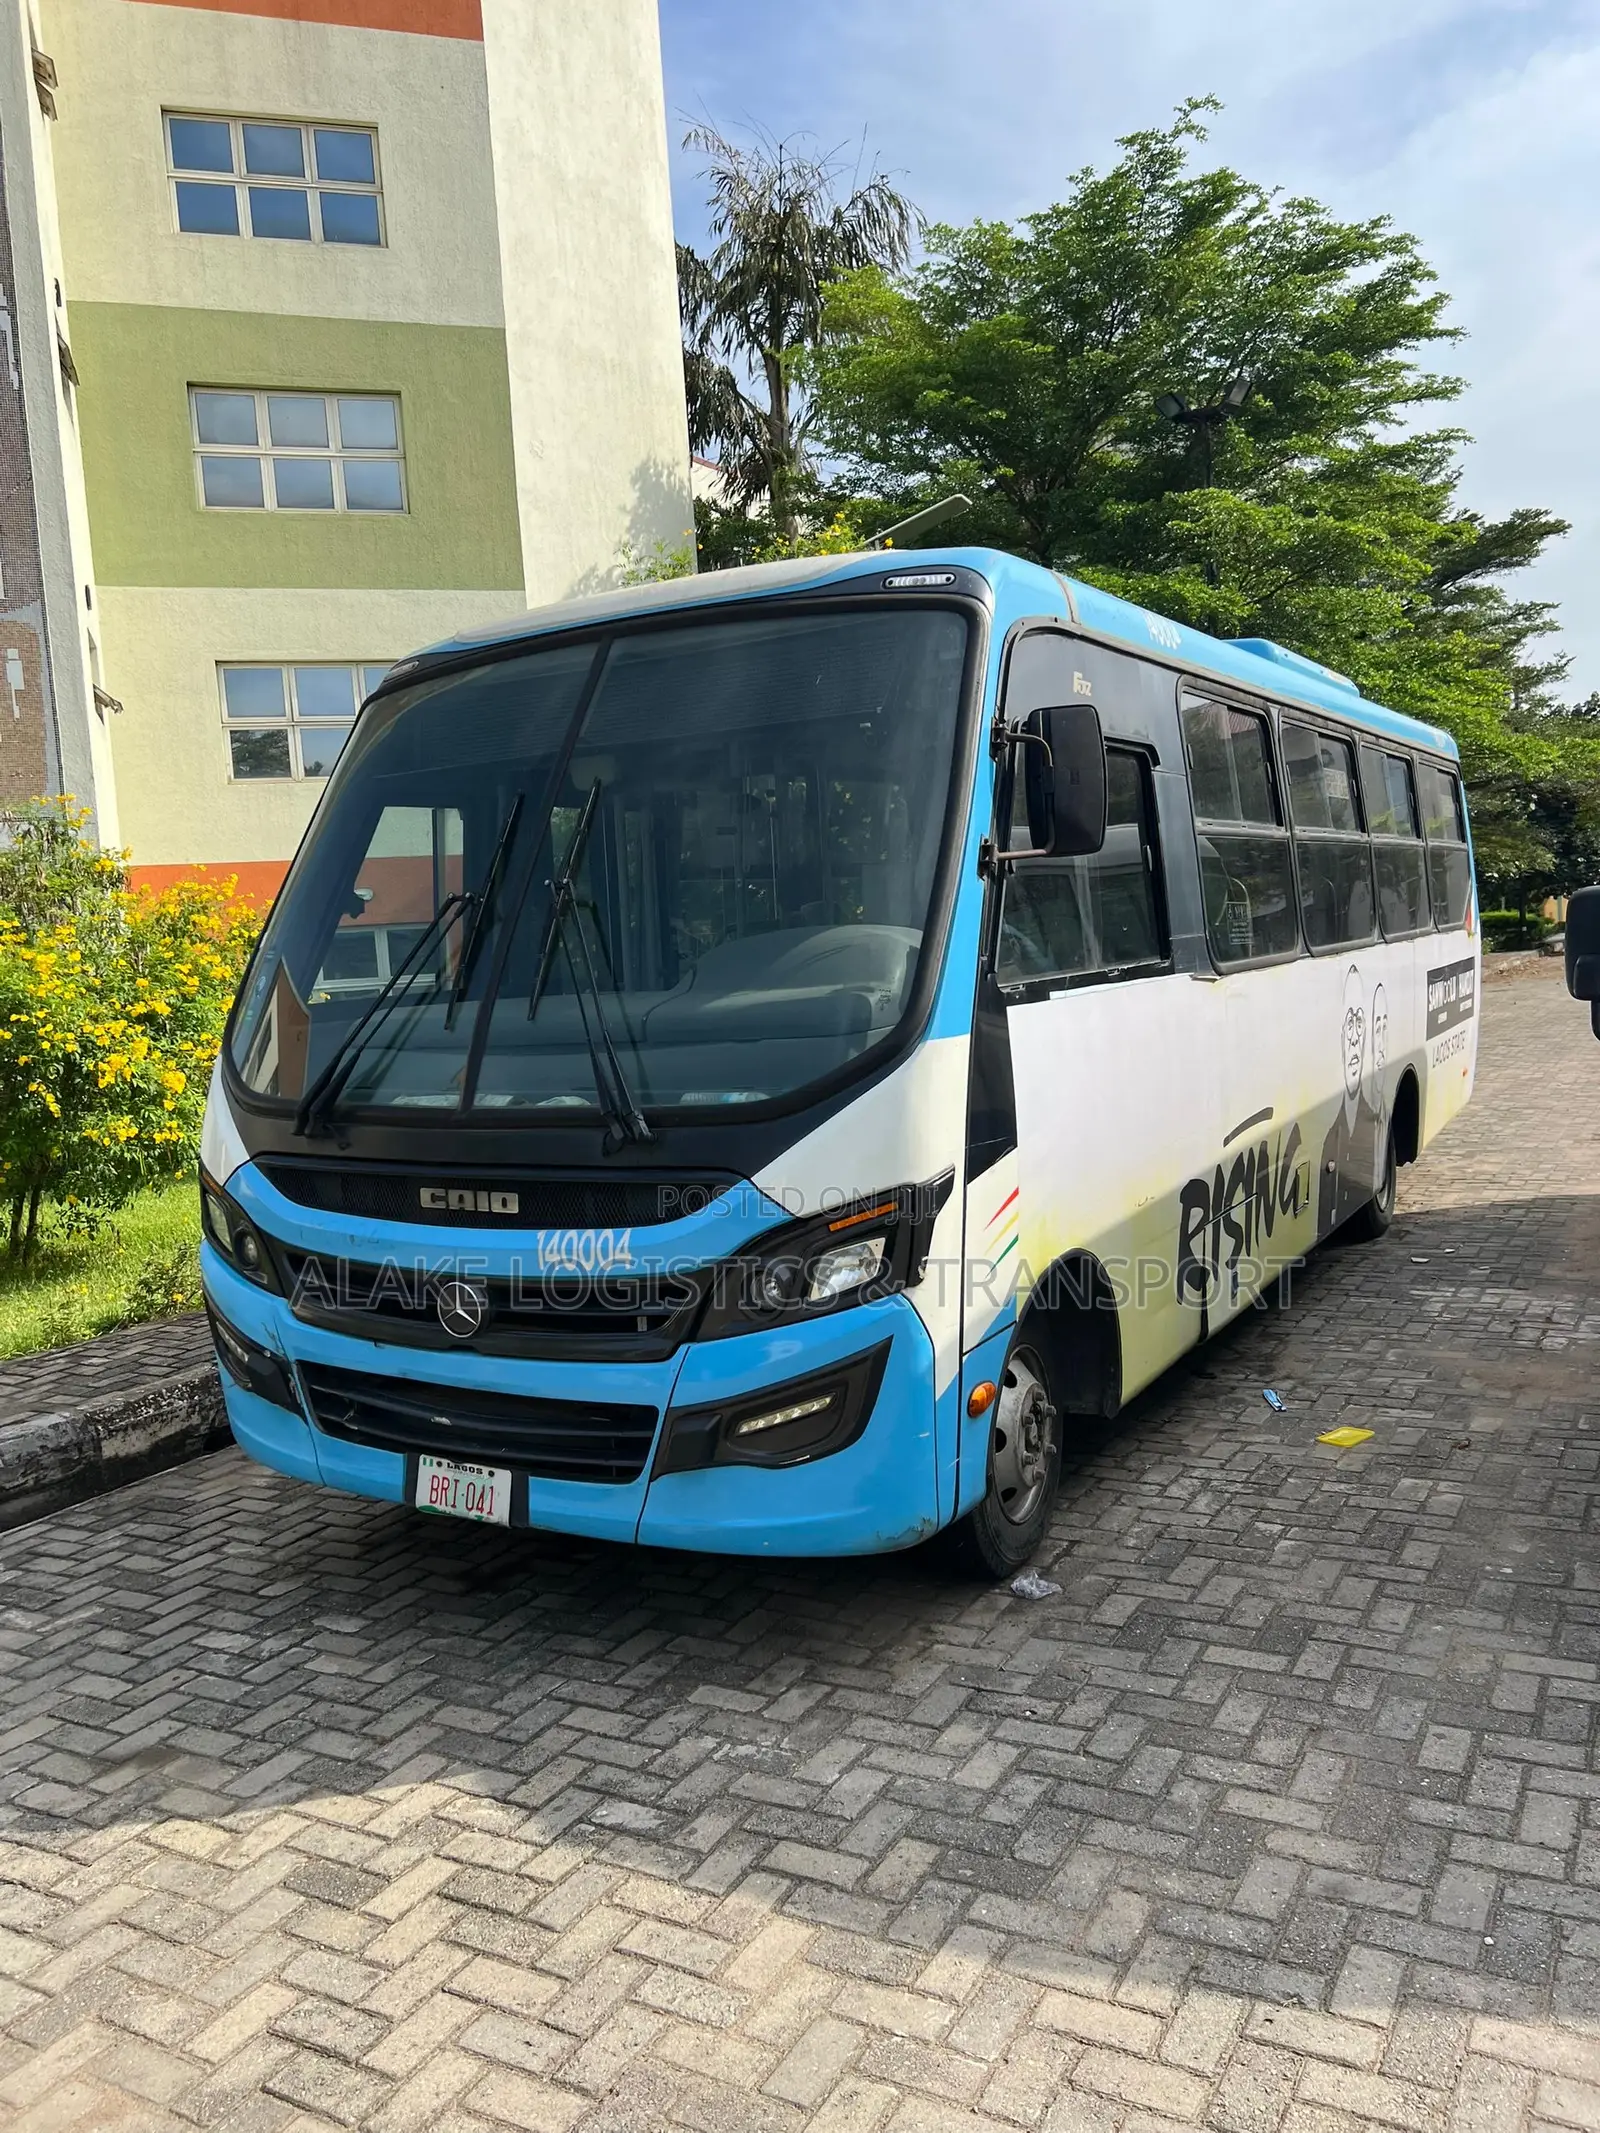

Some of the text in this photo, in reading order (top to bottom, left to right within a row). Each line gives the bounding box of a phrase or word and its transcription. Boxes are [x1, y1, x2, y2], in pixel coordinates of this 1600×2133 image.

[420, 1187, 519, 1214] CAIO
[1177, 1122, 1303, 1306] RISING
[537, 1228, 632, 1271] 140004
[446, 1462, 484, 1475] LAGOS
